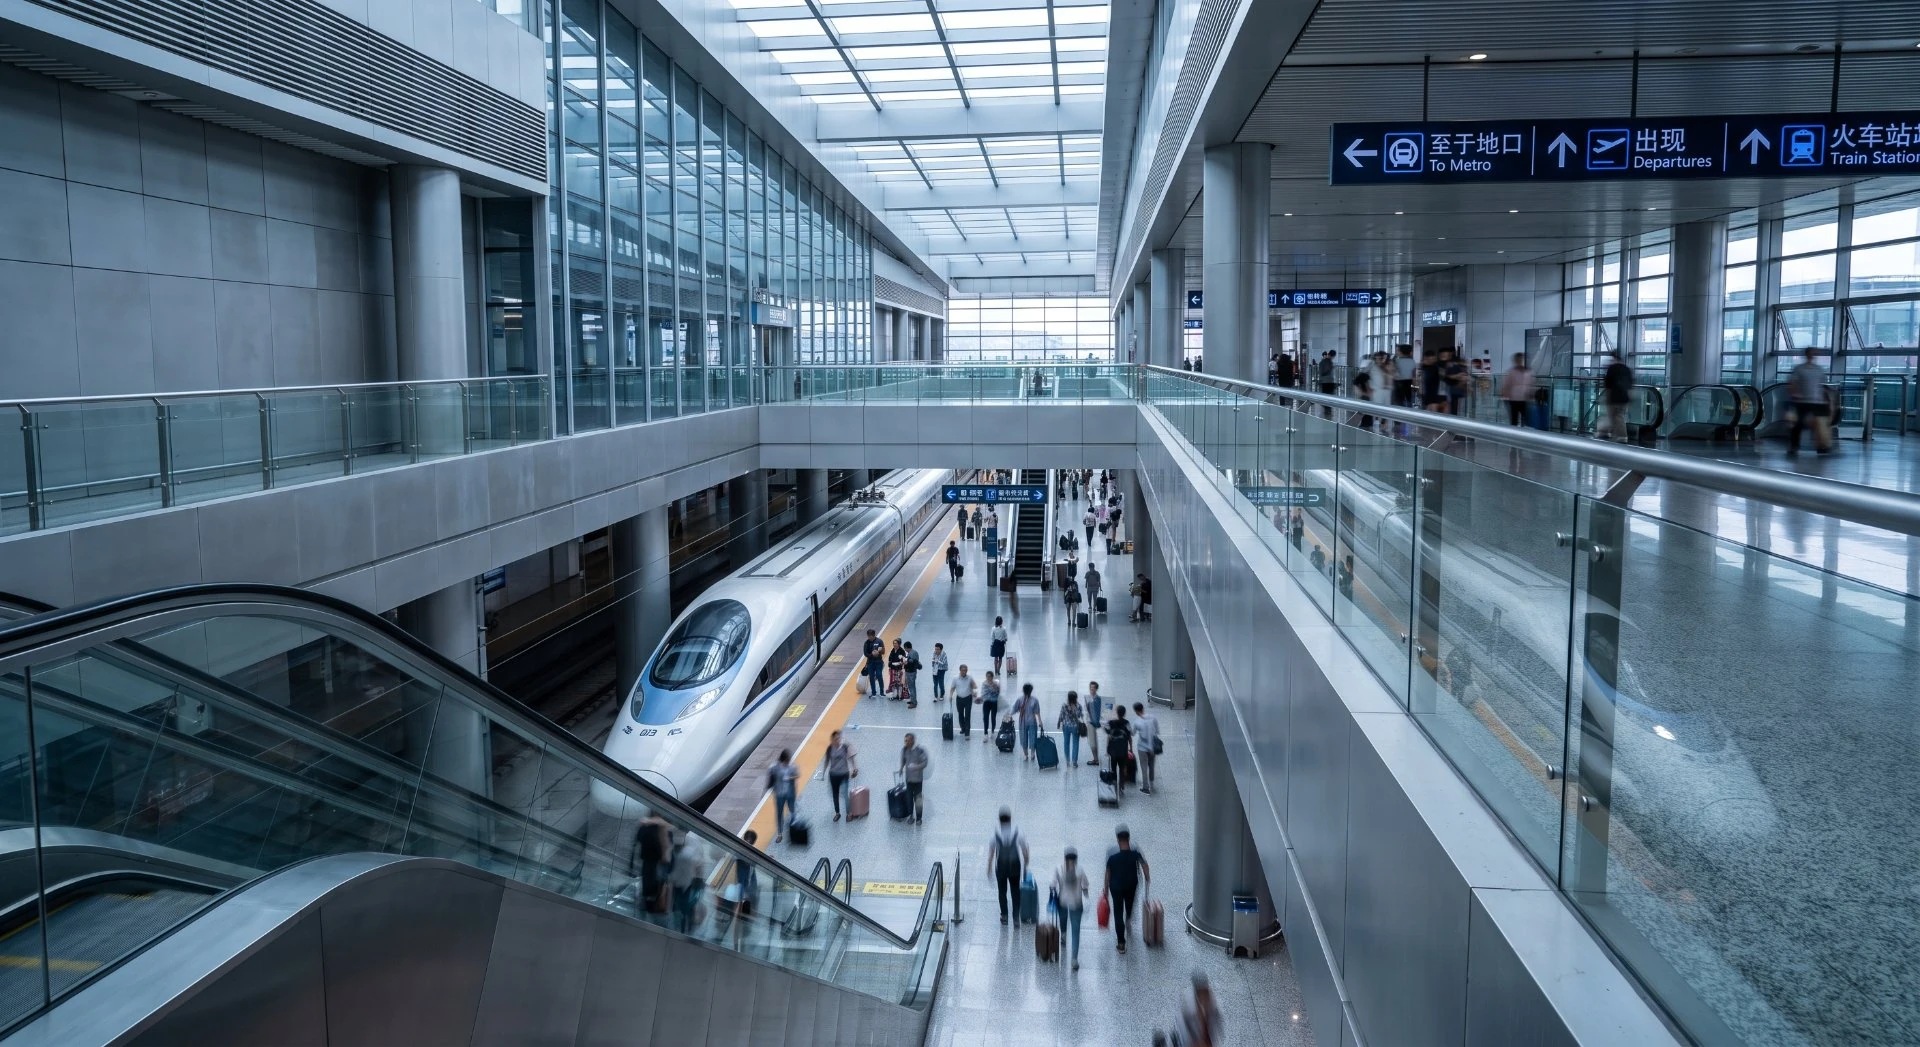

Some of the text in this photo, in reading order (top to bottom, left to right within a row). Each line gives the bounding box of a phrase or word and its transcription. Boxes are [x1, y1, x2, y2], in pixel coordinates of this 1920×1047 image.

[1429, 132, 1522, 155] 至于地口
[1635, 128, 1686, 153] 出现
[1830, 122, 1920, 148] 火车站
[1429, 158, 1492, 172] To Metro
[1634, 155, 1712, 171] Departures
[1830, 151, 1868, 165] Train
